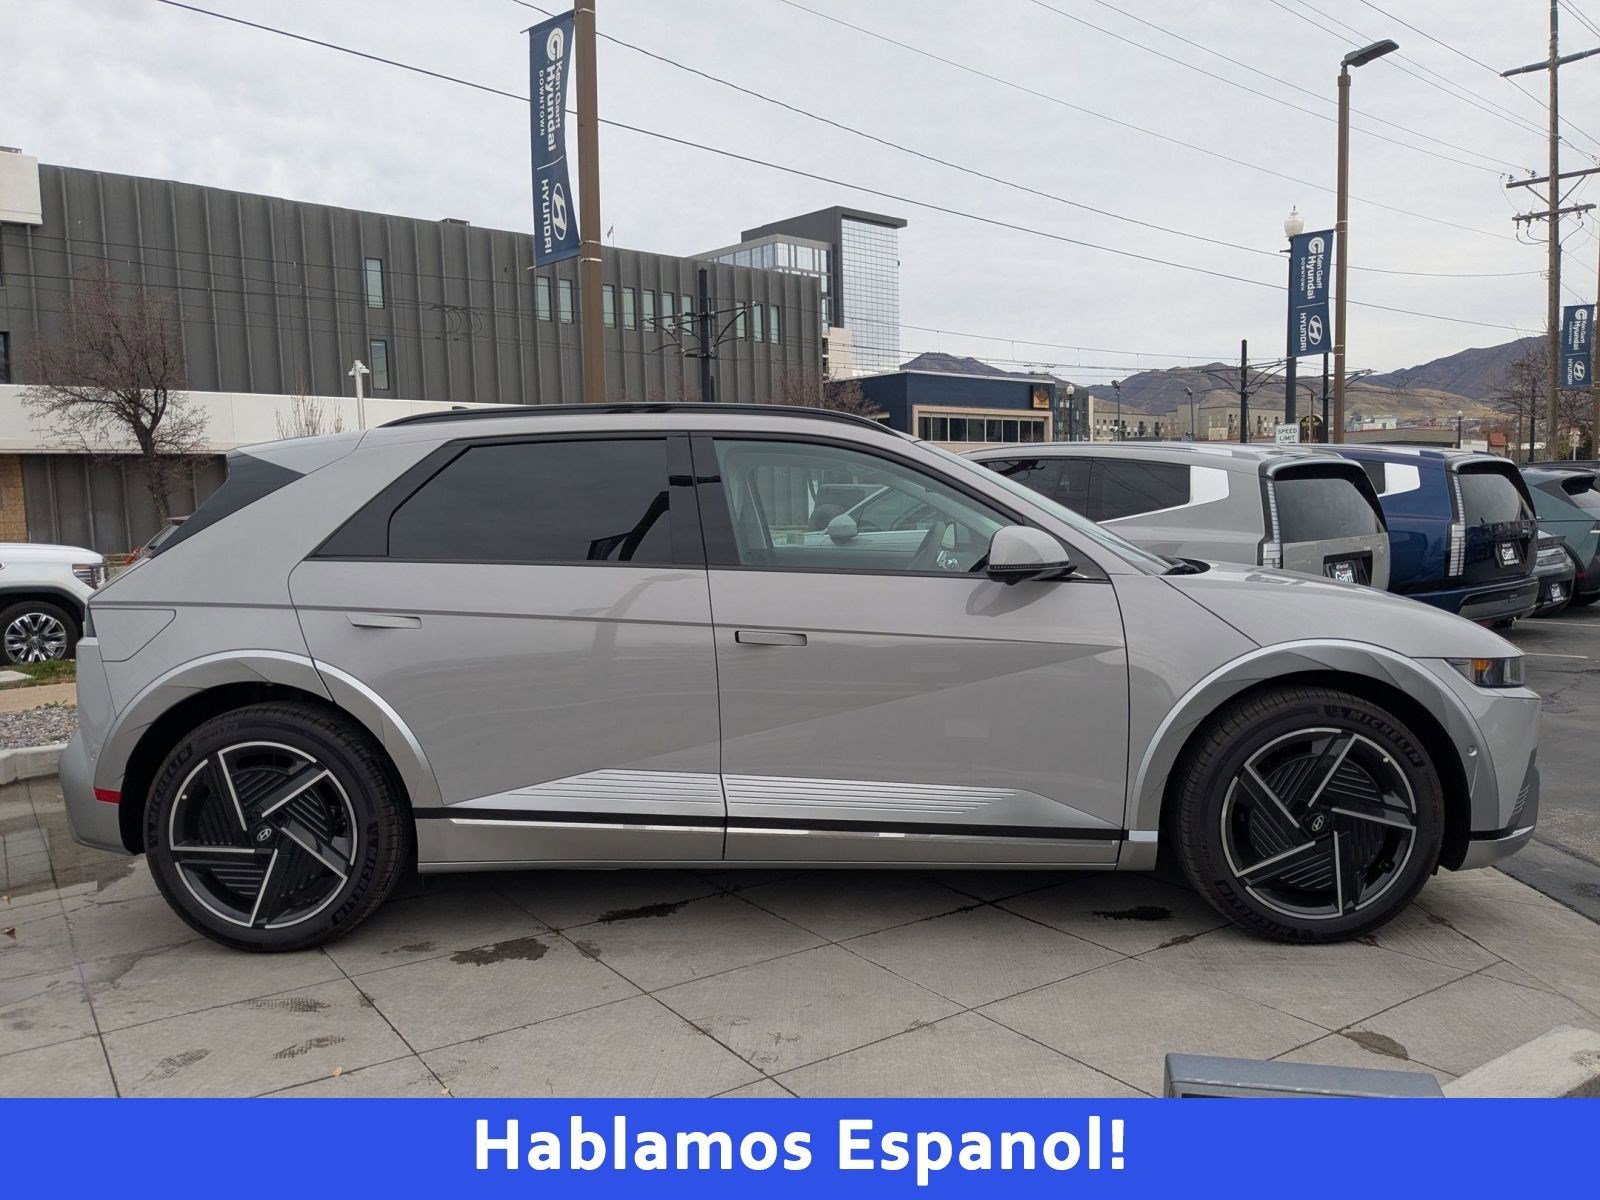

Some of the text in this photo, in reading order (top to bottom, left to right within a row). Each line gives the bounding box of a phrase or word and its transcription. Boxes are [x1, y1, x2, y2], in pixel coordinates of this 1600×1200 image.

[546, 67, 557, 152] Hyundai
[553, 61, 563, 130] Ken Garff
[541, 179, 553, 254] HYUNDAI
[1307, 256, 1316, 300] Hyundai
[1277, 427, 1298, 435] SPEED
[1349, 709, 1423, 767] MICHELIN
